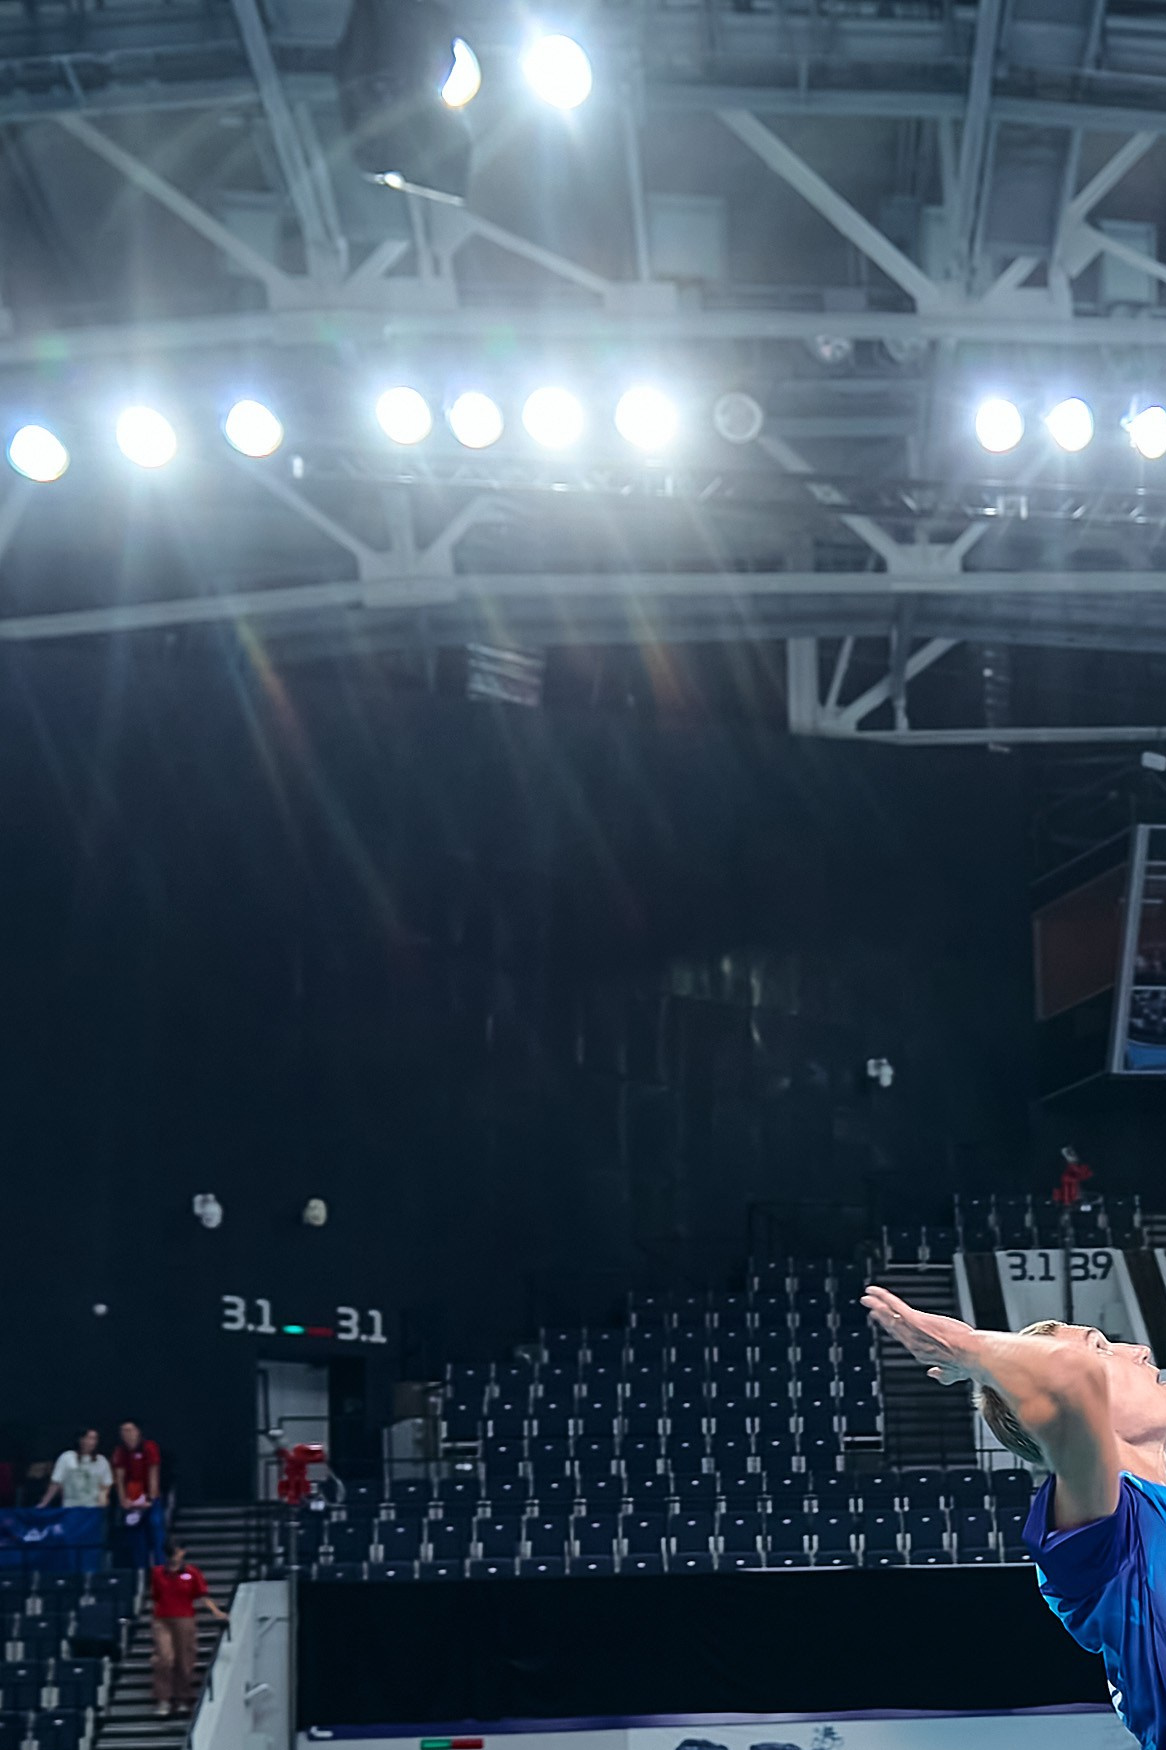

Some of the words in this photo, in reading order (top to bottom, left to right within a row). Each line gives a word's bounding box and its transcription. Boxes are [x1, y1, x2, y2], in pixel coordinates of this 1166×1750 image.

[1005, 1251, 1056, 1281] 3.1
[221, 1295, 277, 1334] 3.1
[336, 1306, 388, 1344] 3.1
